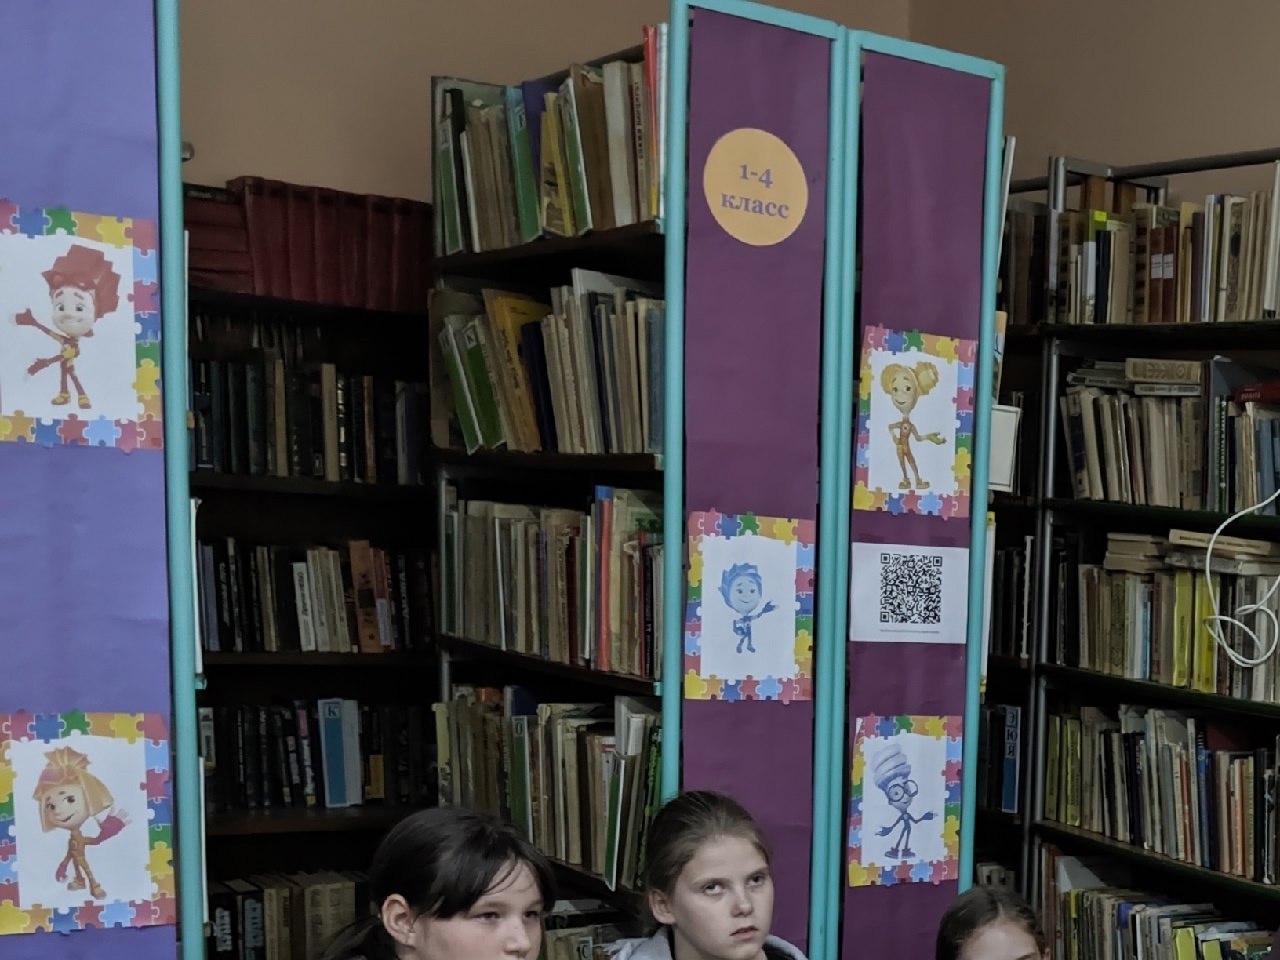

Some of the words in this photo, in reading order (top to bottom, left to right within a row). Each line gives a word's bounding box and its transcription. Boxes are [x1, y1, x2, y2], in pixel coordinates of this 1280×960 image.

[739, 164, 774, 189] 1-4
[721, 192, 789, 218] класс
[328, 705, 337, 717] К
